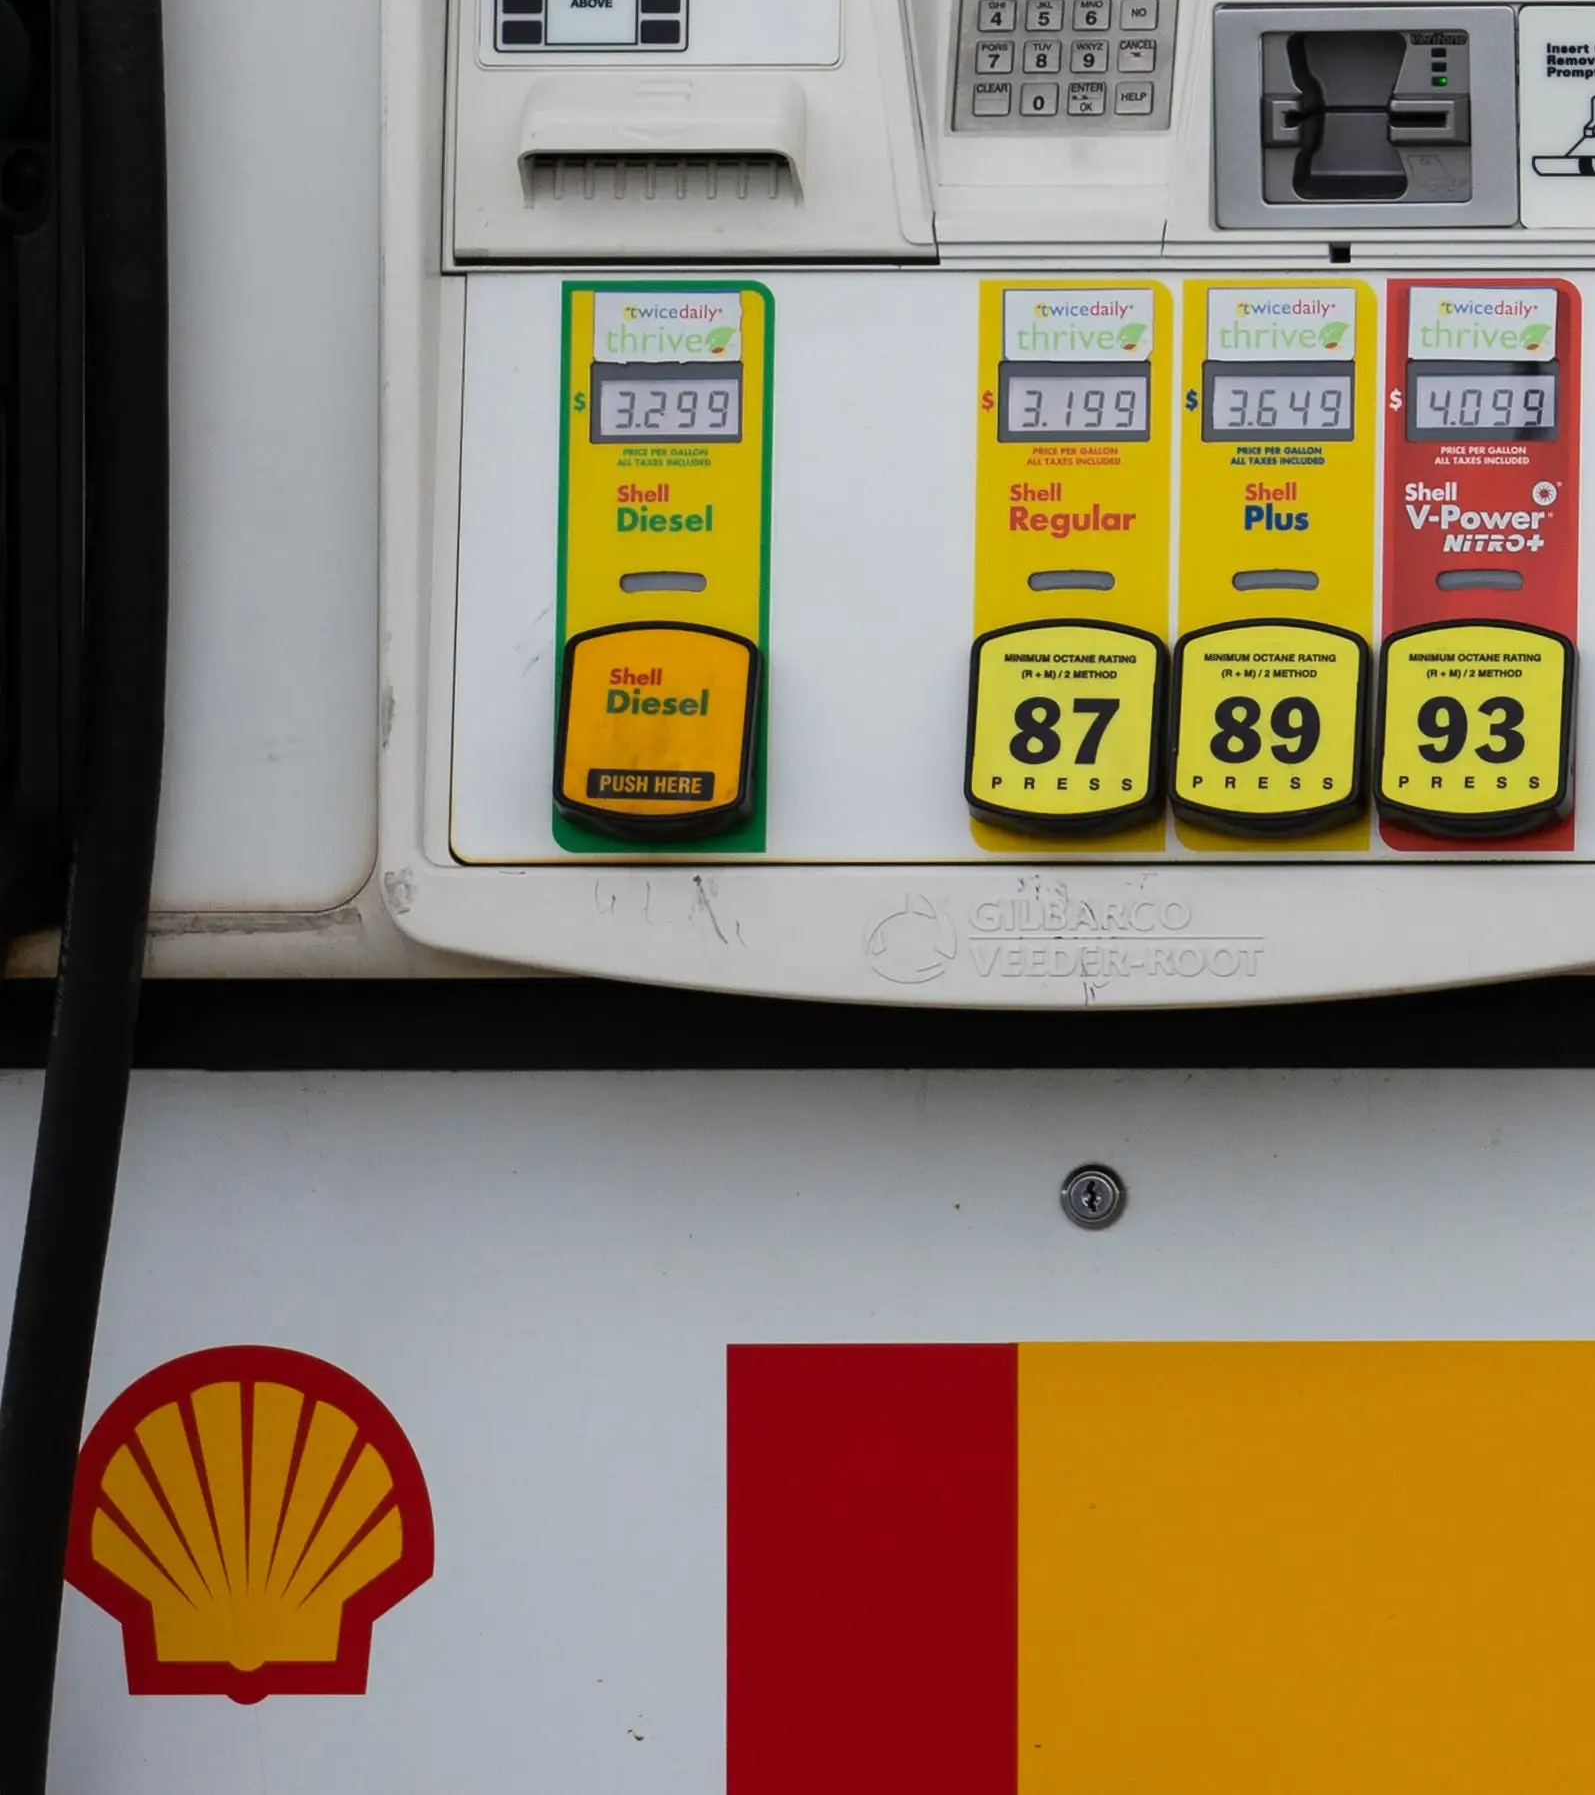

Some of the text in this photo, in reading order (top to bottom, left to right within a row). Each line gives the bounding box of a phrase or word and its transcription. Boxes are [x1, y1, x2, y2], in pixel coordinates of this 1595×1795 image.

[1131, 8, 1147, 17] NO
[1120, 40, 1154, 49] CANCEL
[1546, 43, 1590, 55] Insert
[977, 84, 1008, 93] CLEAR
[1071, 83, 1103, 92] ENTER
[1121, 93, 1146, 101] HELP
[1080, 103, 1092, 112] OK
[615, 390, 729, 429] 3.299
[1022, 390, 1136, 428] 3.199
[1229, 390, 1342, 427] 3.649
[1430, 388, 1545, 426] 4.099
[617, 484, 669, 502] Shell
[1010, 482, 1062, 502] Shell
[1245, 482, 1297, 502] Shell
[1405, 482, 1457, 502] Shell
[617, 505, 713, 532] Diesel
[1009, 504, 1136, 539] Regular
[1244, 504, 1309, 531] Plus
[1406, 504, 1546, 530] V-Power
[610, 668, 662, 686] Shell
[607, 688, 709, 716] Diesel
[1009, 695, 1120, 765] 87
[1210, 695, 1321, 765] 89
[1416, 695, 1526, 764] 93
[600, 775, 702, 794] PUSH HERE
[969, 901, 1192, 933] GILBARCO
[969, 946, 1265, 978] VEEDER-ROOT
